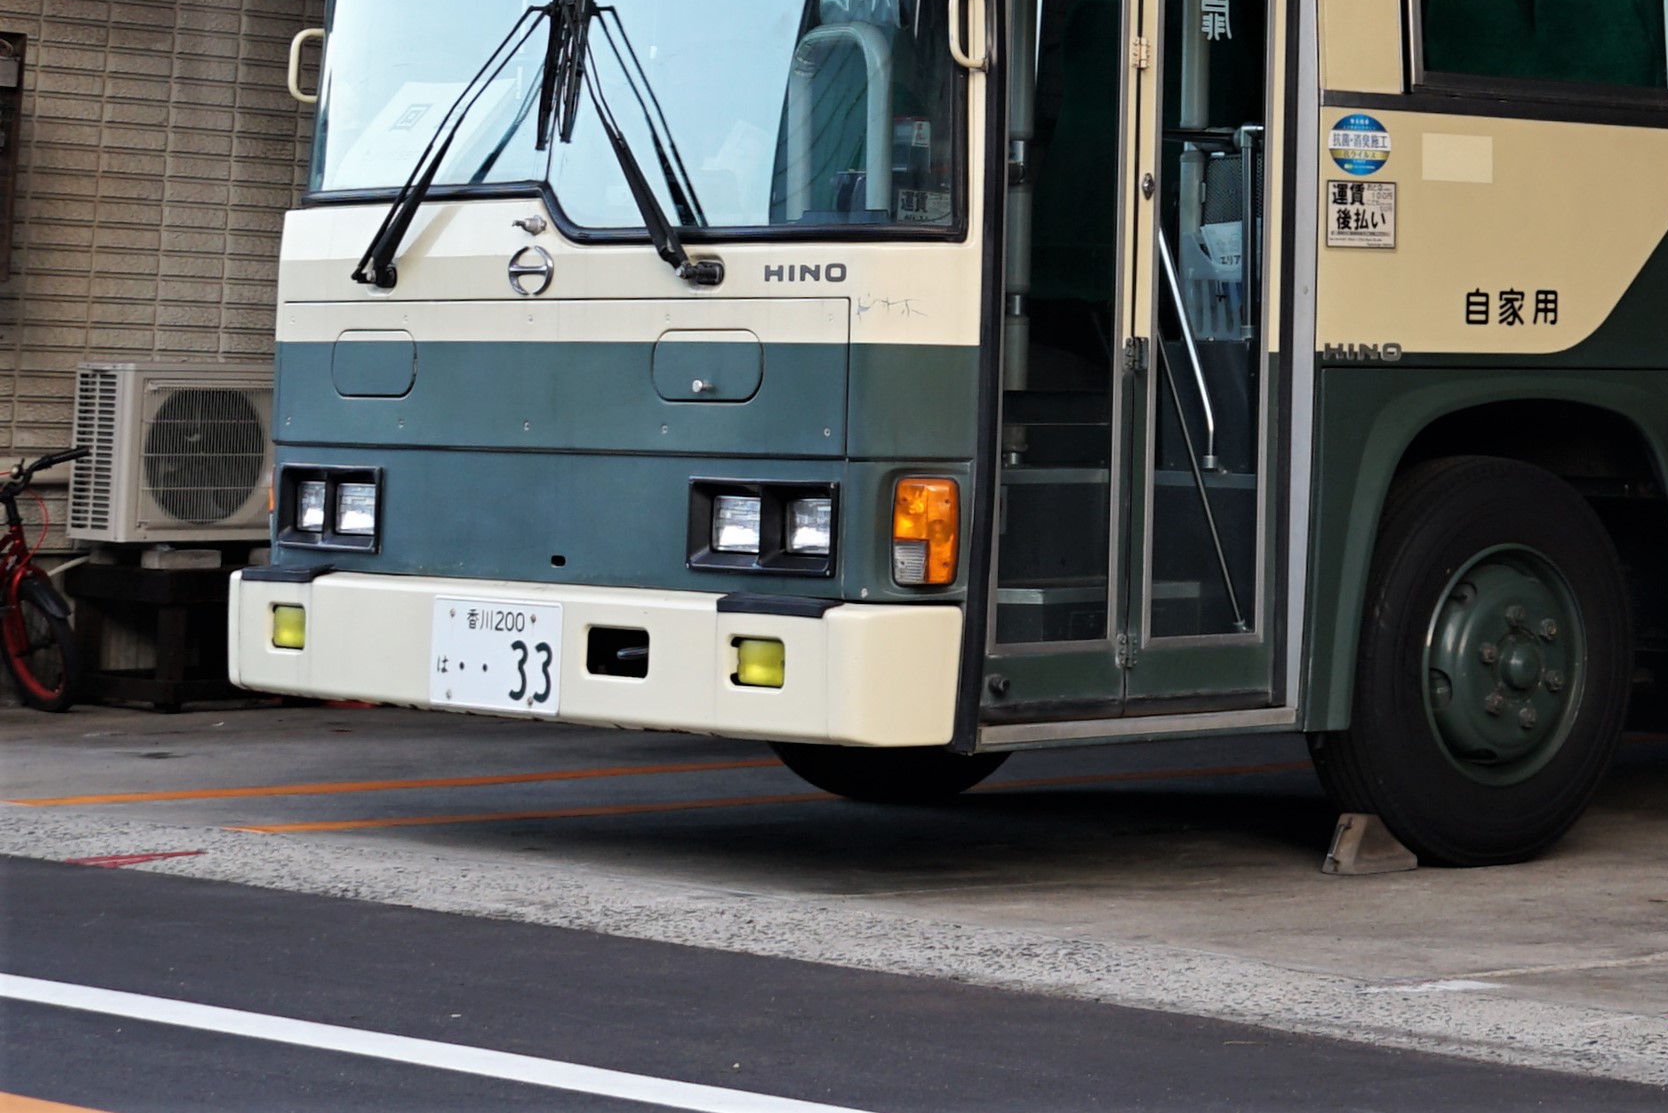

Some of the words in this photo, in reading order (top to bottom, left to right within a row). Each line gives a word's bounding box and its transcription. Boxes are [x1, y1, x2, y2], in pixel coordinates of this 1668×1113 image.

[1332, 183, 1365, 206] 運賃
[1336, 208, 1386, 230] 後払い
[764, 263, 848, 283] HINO
[1465, 288, 1559, 327] 自家用
[1323, 342, 1403, 362] HINO
